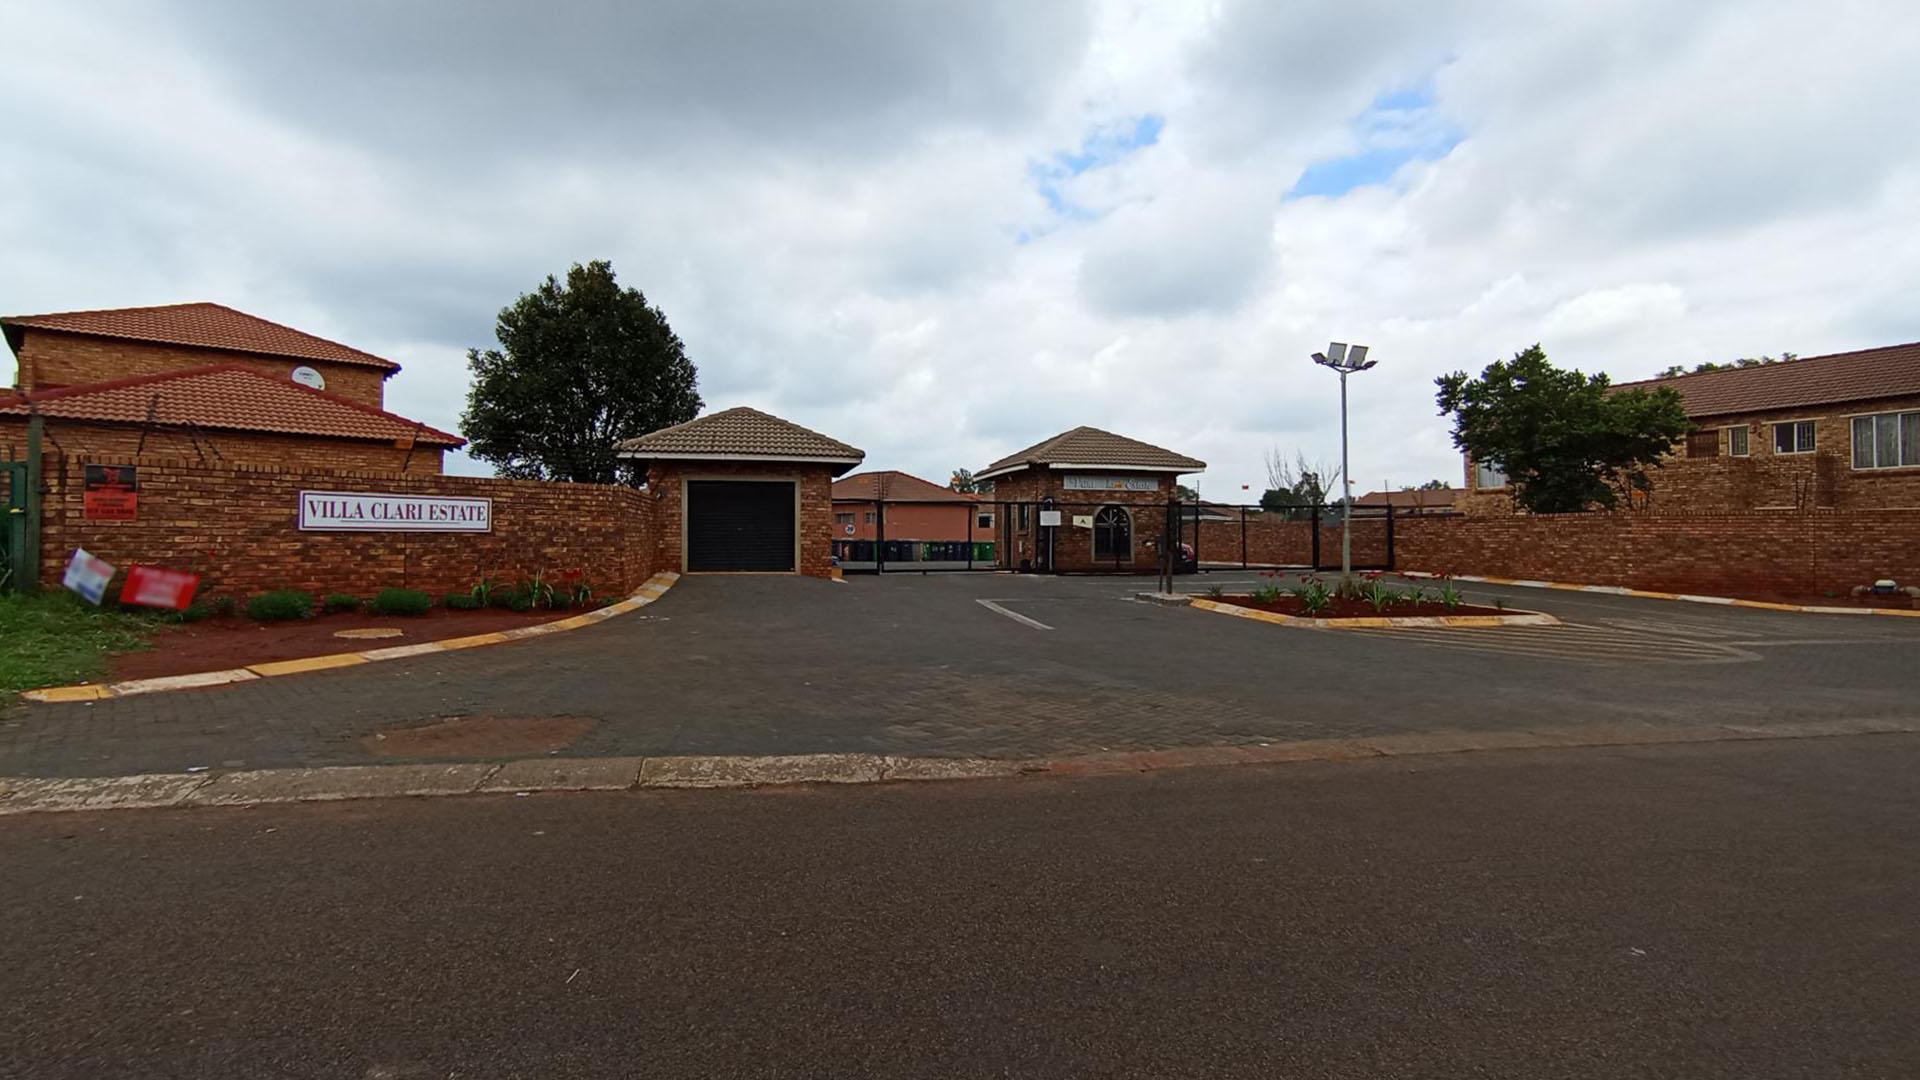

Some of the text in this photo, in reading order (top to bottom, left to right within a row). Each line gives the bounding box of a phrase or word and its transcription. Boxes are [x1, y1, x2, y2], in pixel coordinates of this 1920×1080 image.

[308, 500, 486, 522] VILLA CLARI ESTATE
